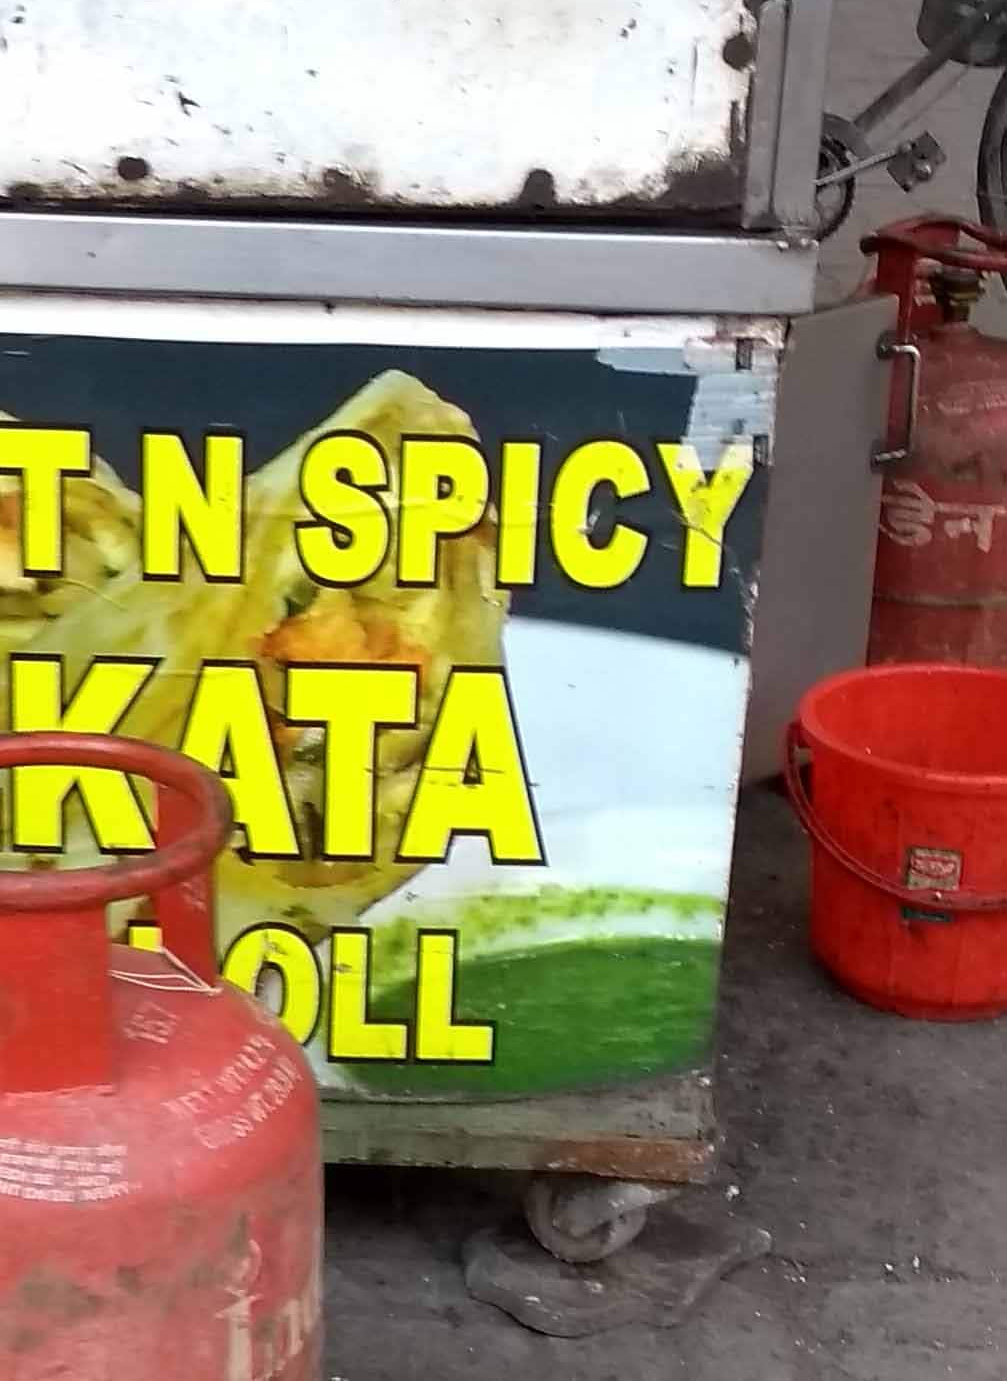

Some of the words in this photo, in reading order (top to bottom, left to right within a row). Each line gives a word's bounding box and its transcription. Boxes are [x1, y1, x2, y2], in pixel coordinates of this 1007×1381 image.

[141, 425, 246, 583] N
[294, 430, 755, 589] SPICY
[128, 920, 496, 1064] OLL
